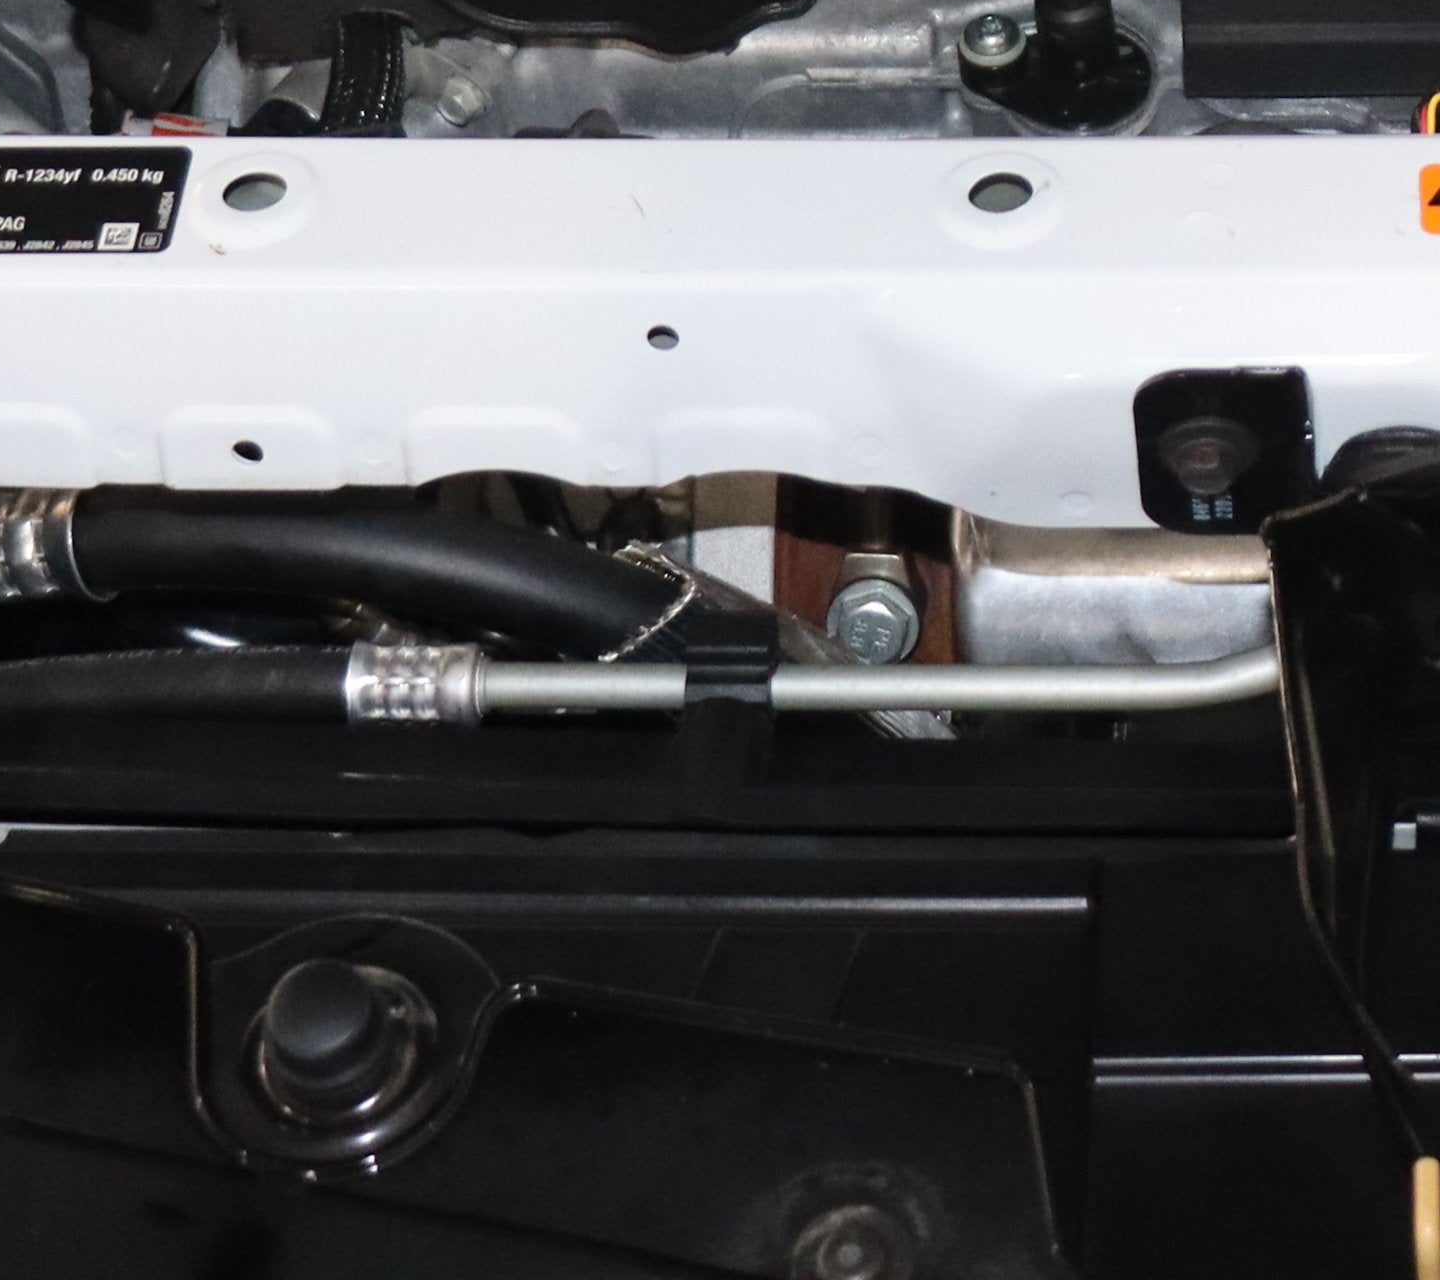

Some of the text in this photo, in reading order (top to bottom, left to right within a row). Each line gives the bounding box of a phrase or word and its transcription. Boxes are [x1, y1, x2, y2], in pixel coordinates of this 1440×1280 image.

[4, 168, 164, 185] R-1234yf 0.450 kg
